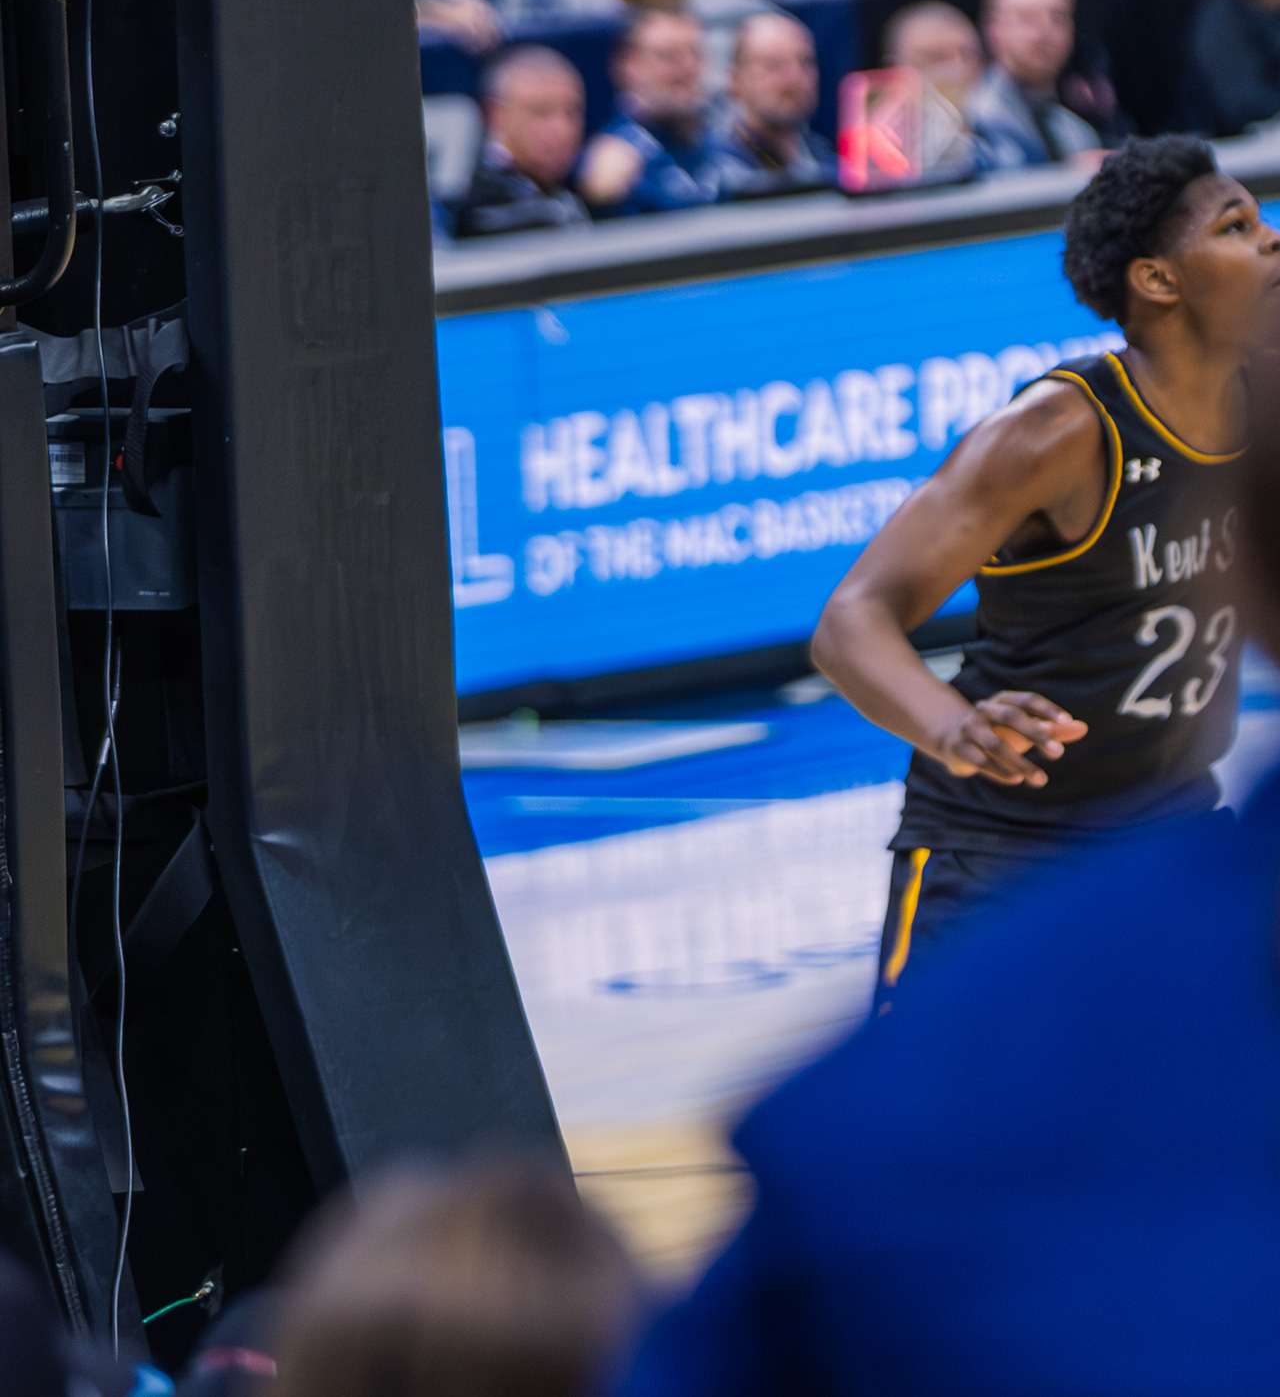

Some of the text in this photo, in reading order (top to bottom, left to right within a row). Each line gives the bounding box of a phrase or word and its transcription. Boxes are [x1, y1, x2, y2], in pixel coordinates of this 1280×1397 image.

[519, 363, 917, 514] HEALTHCARE
[524, 531, 583, 597] OF
[583, 515, 664, 583] THE
[663, 502, 754, 570] MAC
[1127, 521, 1211, 590] Kent
[1114, 603, 1237, 721] 23
